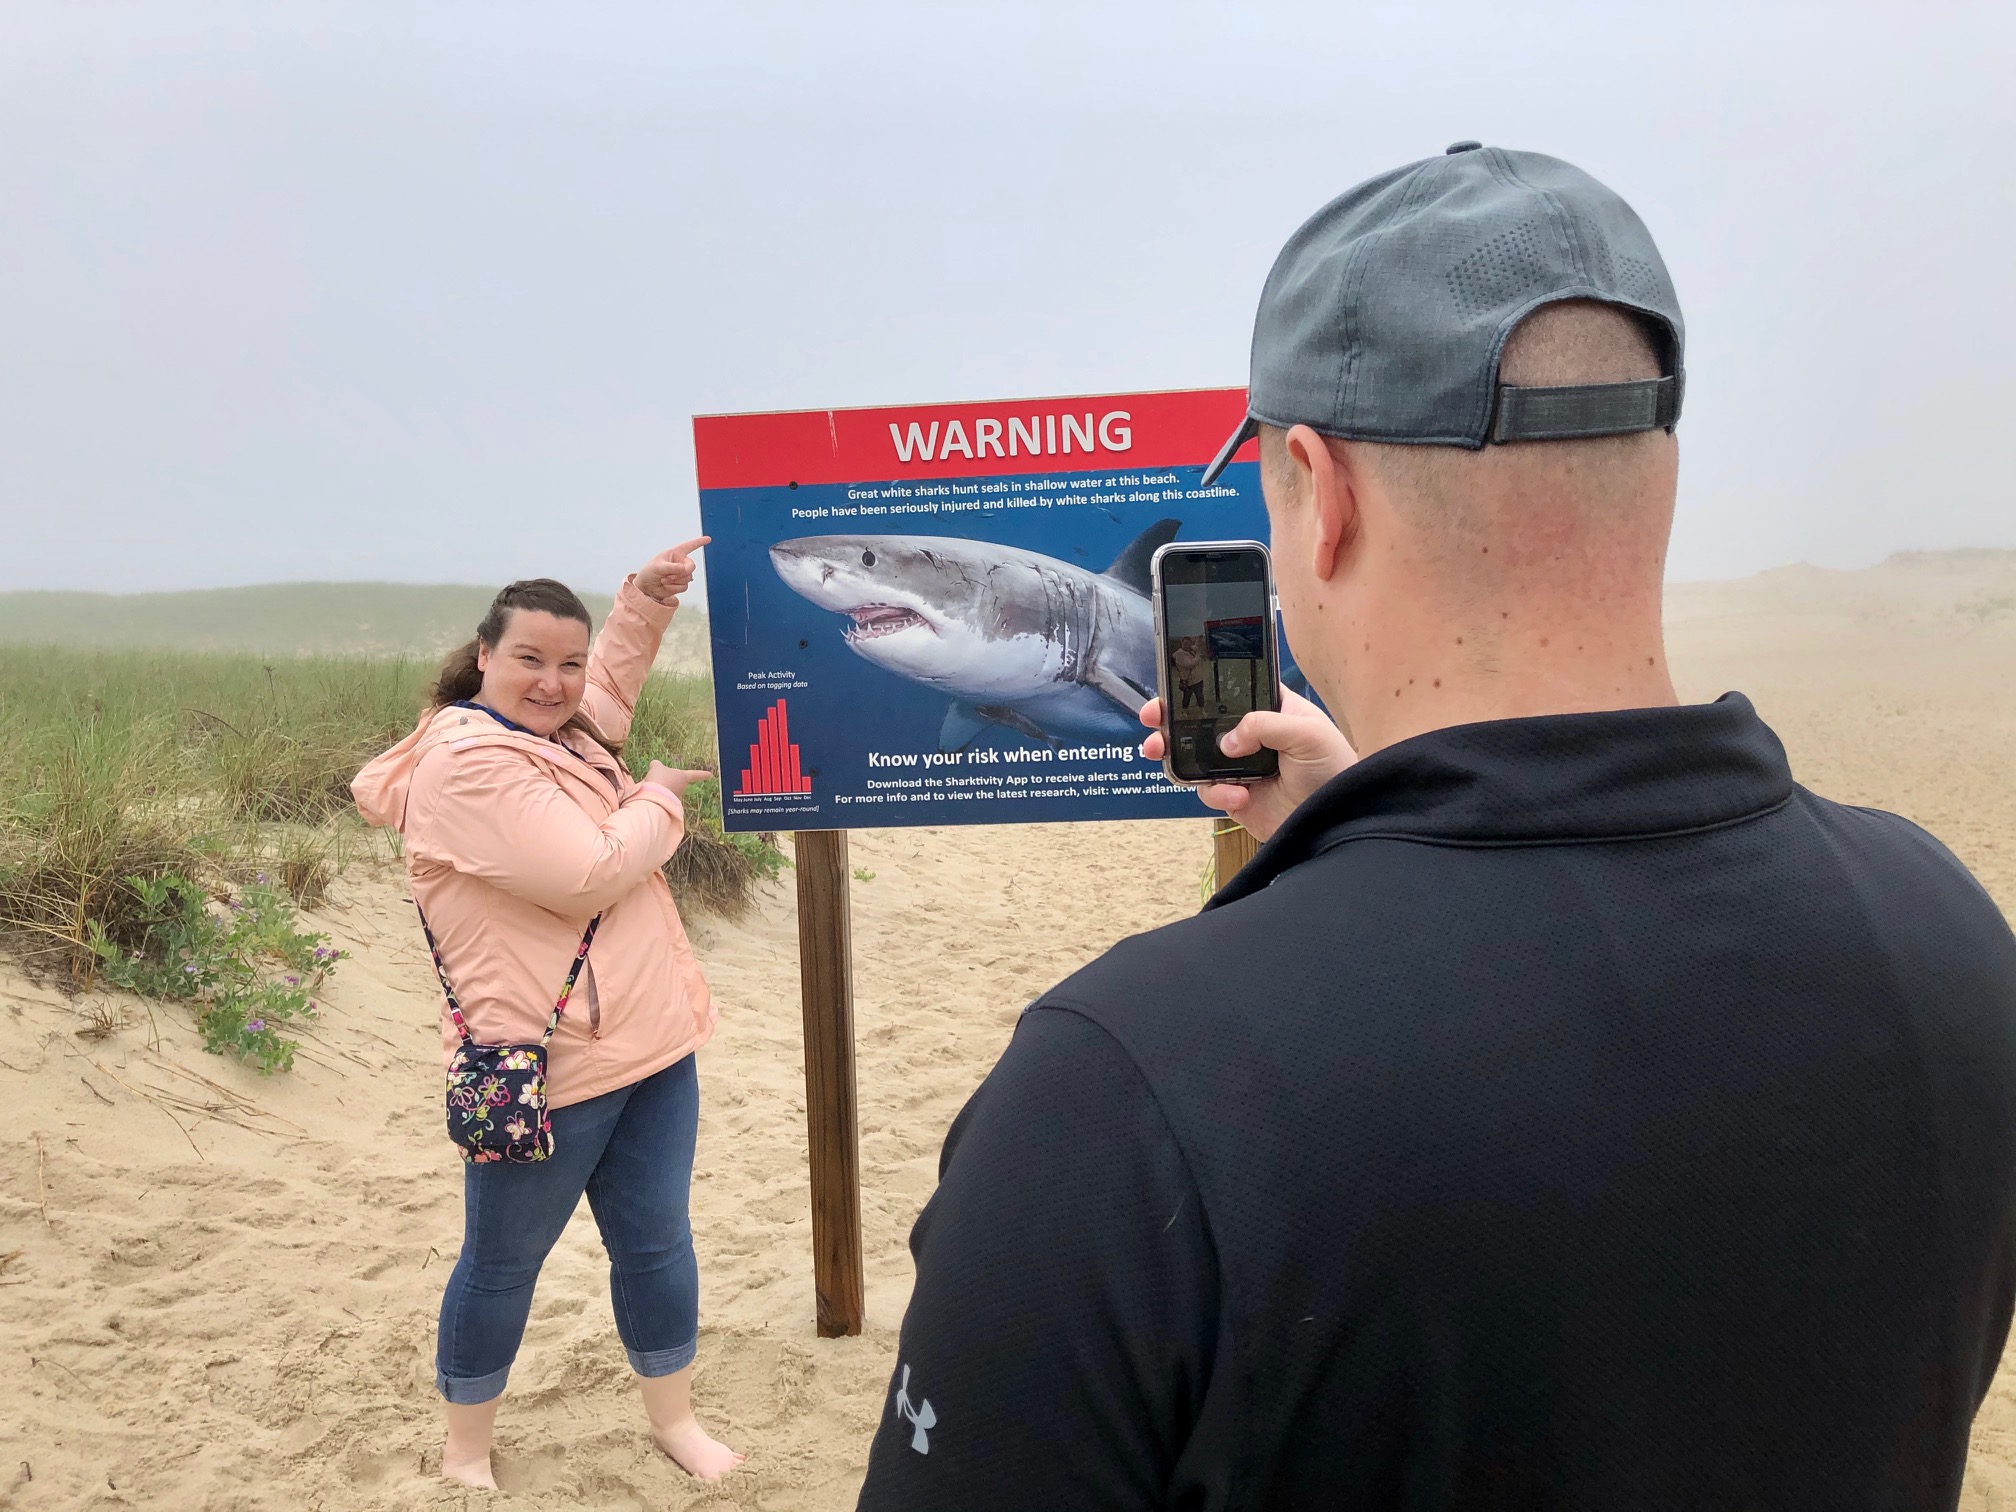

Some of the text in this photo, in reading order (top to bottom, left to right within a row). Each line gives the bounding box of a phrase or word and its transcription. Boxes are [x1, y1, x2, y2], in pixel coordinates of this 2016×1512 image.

[889, 410, 1132, 462] WARNING
[848, 473, 1179, 500] Great white sharks hunt seals in shallow water at this beach.
[792, 487, 1239, 519] People have been seriously injured and killed by white sharks along this coastline.
[768, 671, 795, 679] Activity
[768, 682, 791, 690] tagging
[868, 752, 918, 767] Know
[922, 751, 963, 769] your
[967, 748, 999, 764] risk
[1003, 747, 1053, 763] when
[1058, 744, 1133, 762] entering
[867, 778, 922, 789] Download
[925, 778, 943, 787] the
[945, 776, 1003, 787] Sharktivity
[1006, 775, 1028, 785] App
[1031, 775, 1042, 783] to
[1045, 774, 1084, 783] receive
[1087, 772, 1118, 781] alerts
[1121, 771, 1142, 780] and
[835, 784, 1197, 804] For more info and to view the latest research, visit: www.atlanticw
